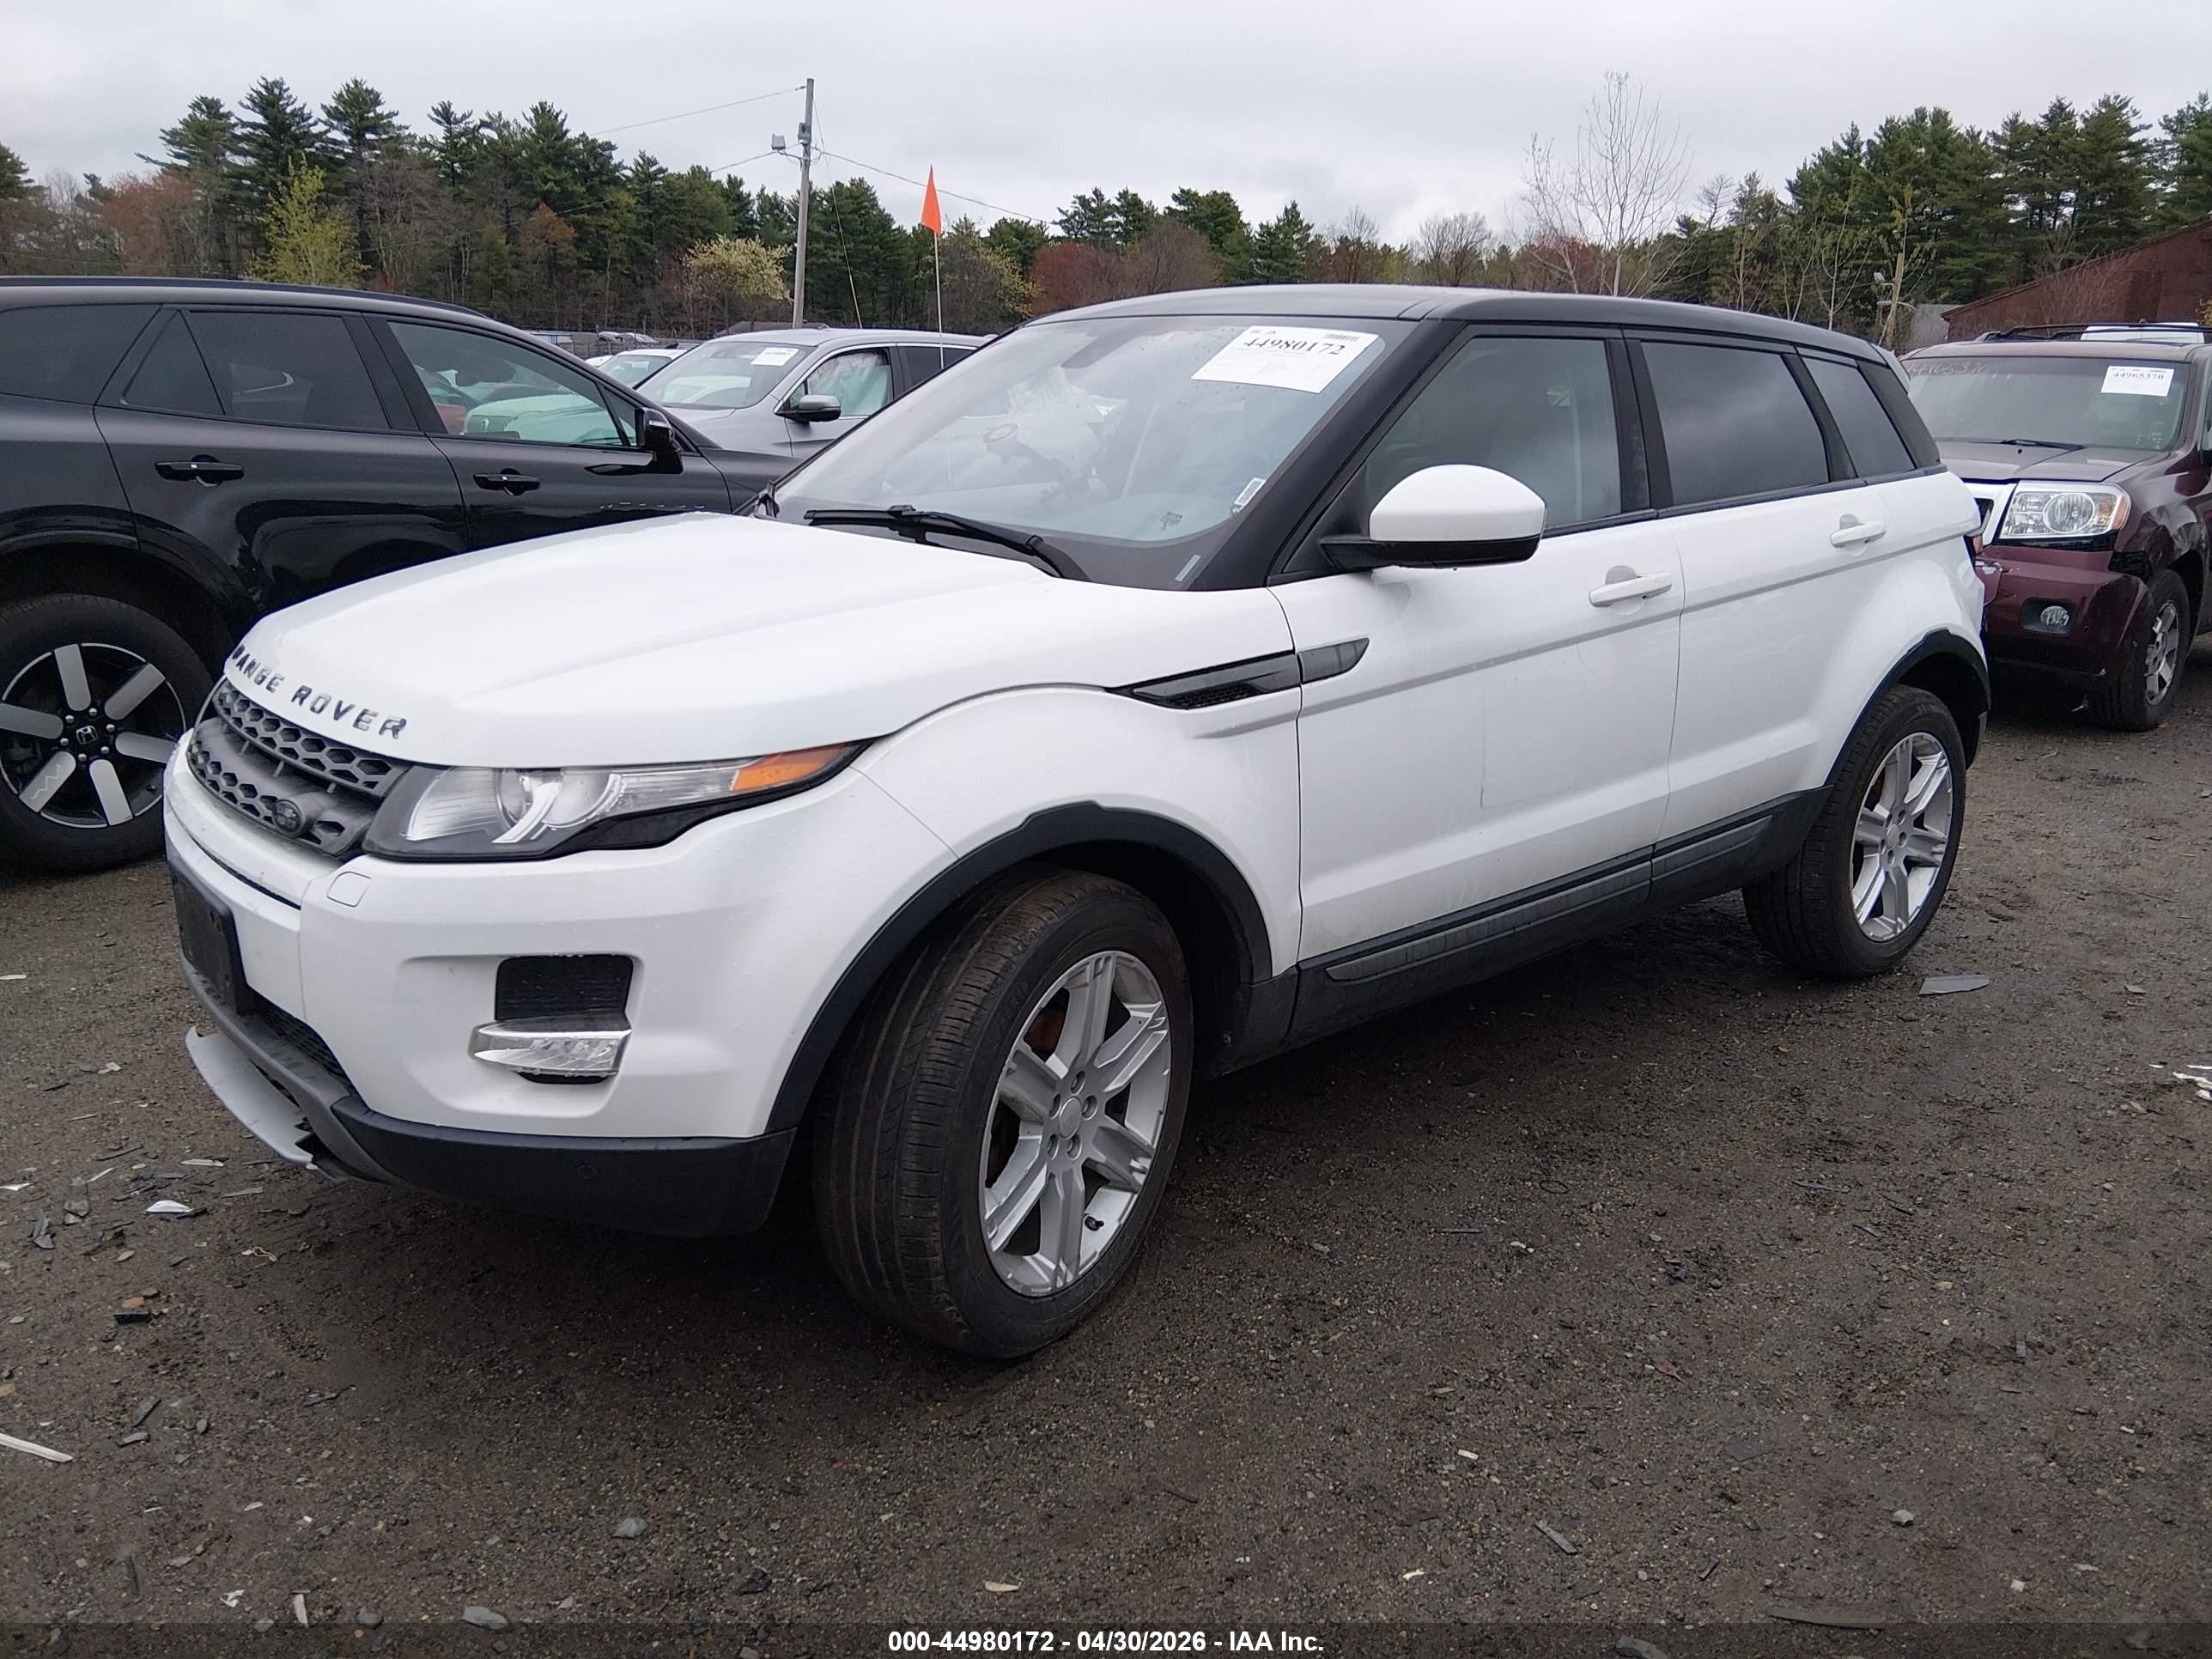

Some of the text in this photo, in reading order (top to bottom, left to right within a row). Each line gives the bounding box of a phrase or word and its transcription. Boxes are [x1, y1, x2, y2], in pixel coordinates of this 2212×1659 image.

[1243, 337, 1346, 356] 44980172
[231, 644, 407, 739] RANGE ROVER
